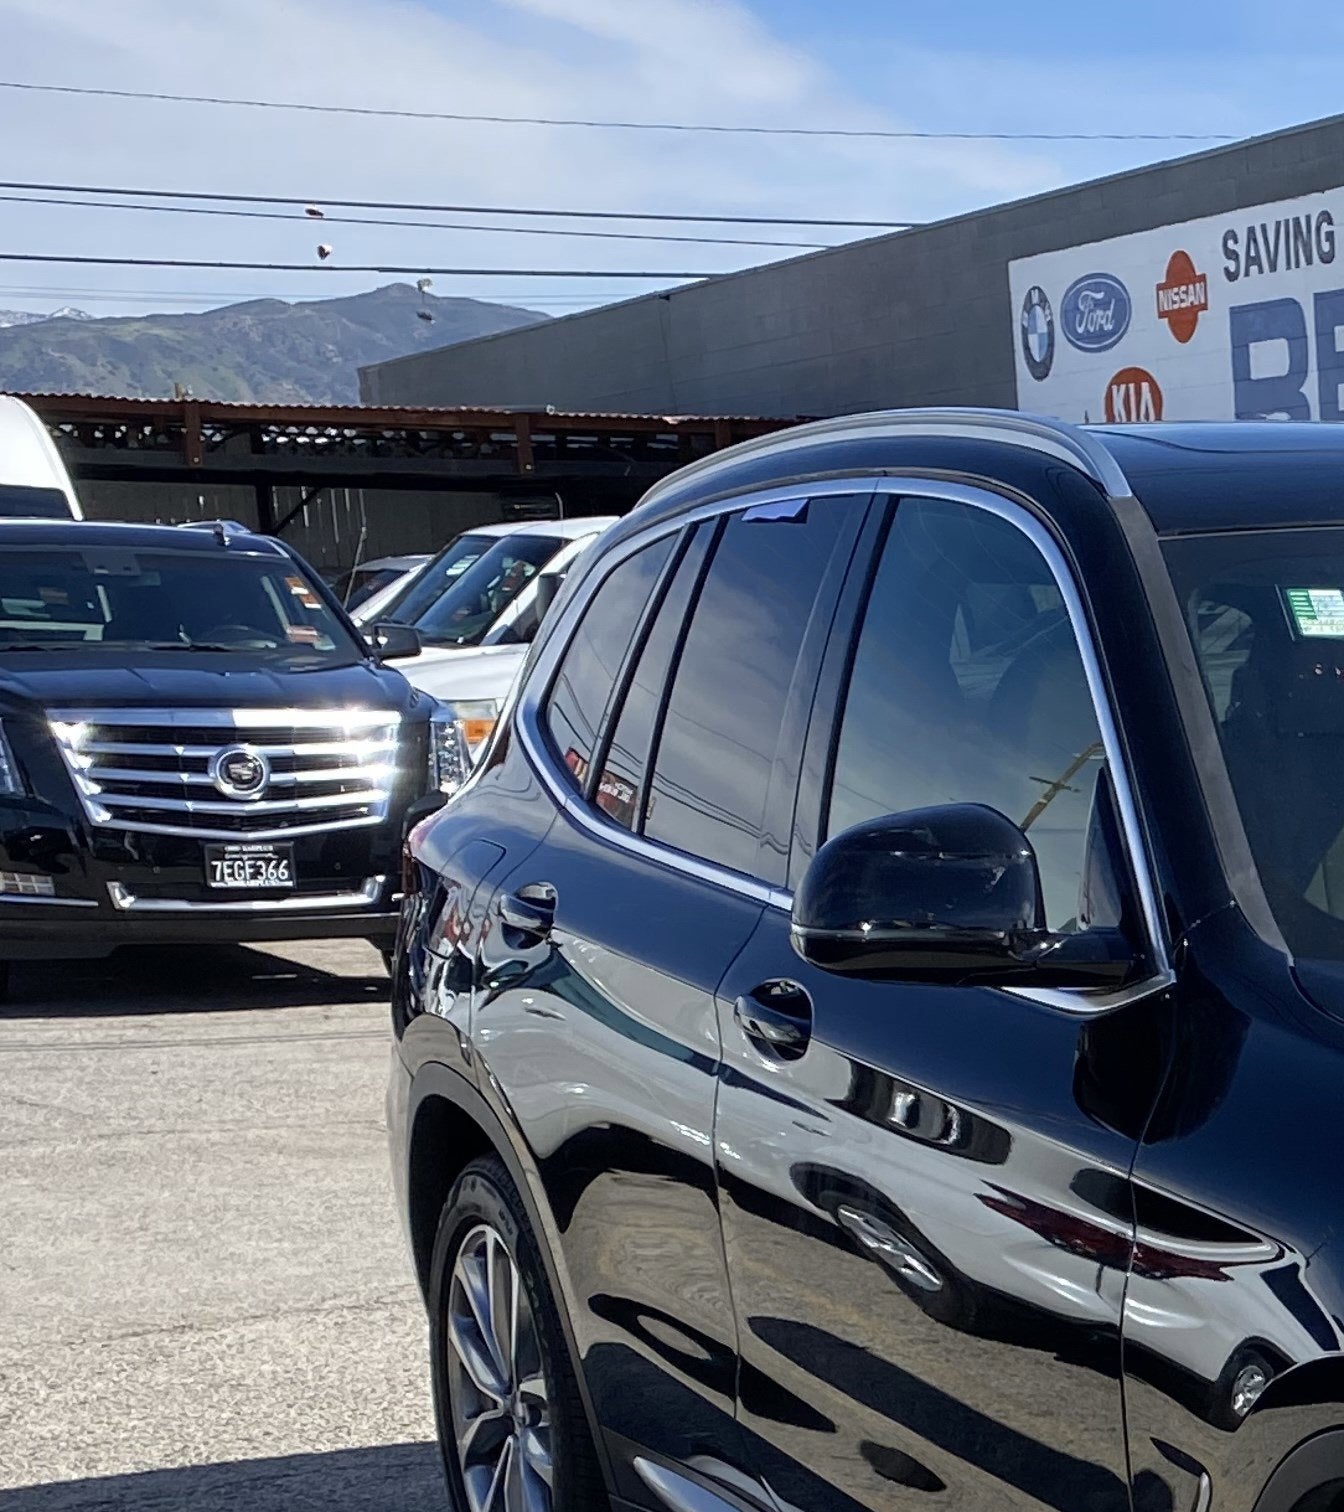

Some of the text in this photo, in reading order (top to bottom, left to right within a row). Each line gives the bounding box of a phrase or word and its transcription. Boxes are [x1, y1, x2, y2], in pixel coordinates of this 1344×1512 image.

[1221, 209, 1335, 283] SAVING
[1074, 289, 1117, 334] Ford
[1158, 281, 1206, 313] NISSAN
[1110, 381, 1156, 422] KIA
[210, 859, 289, 883] 7EGF366
